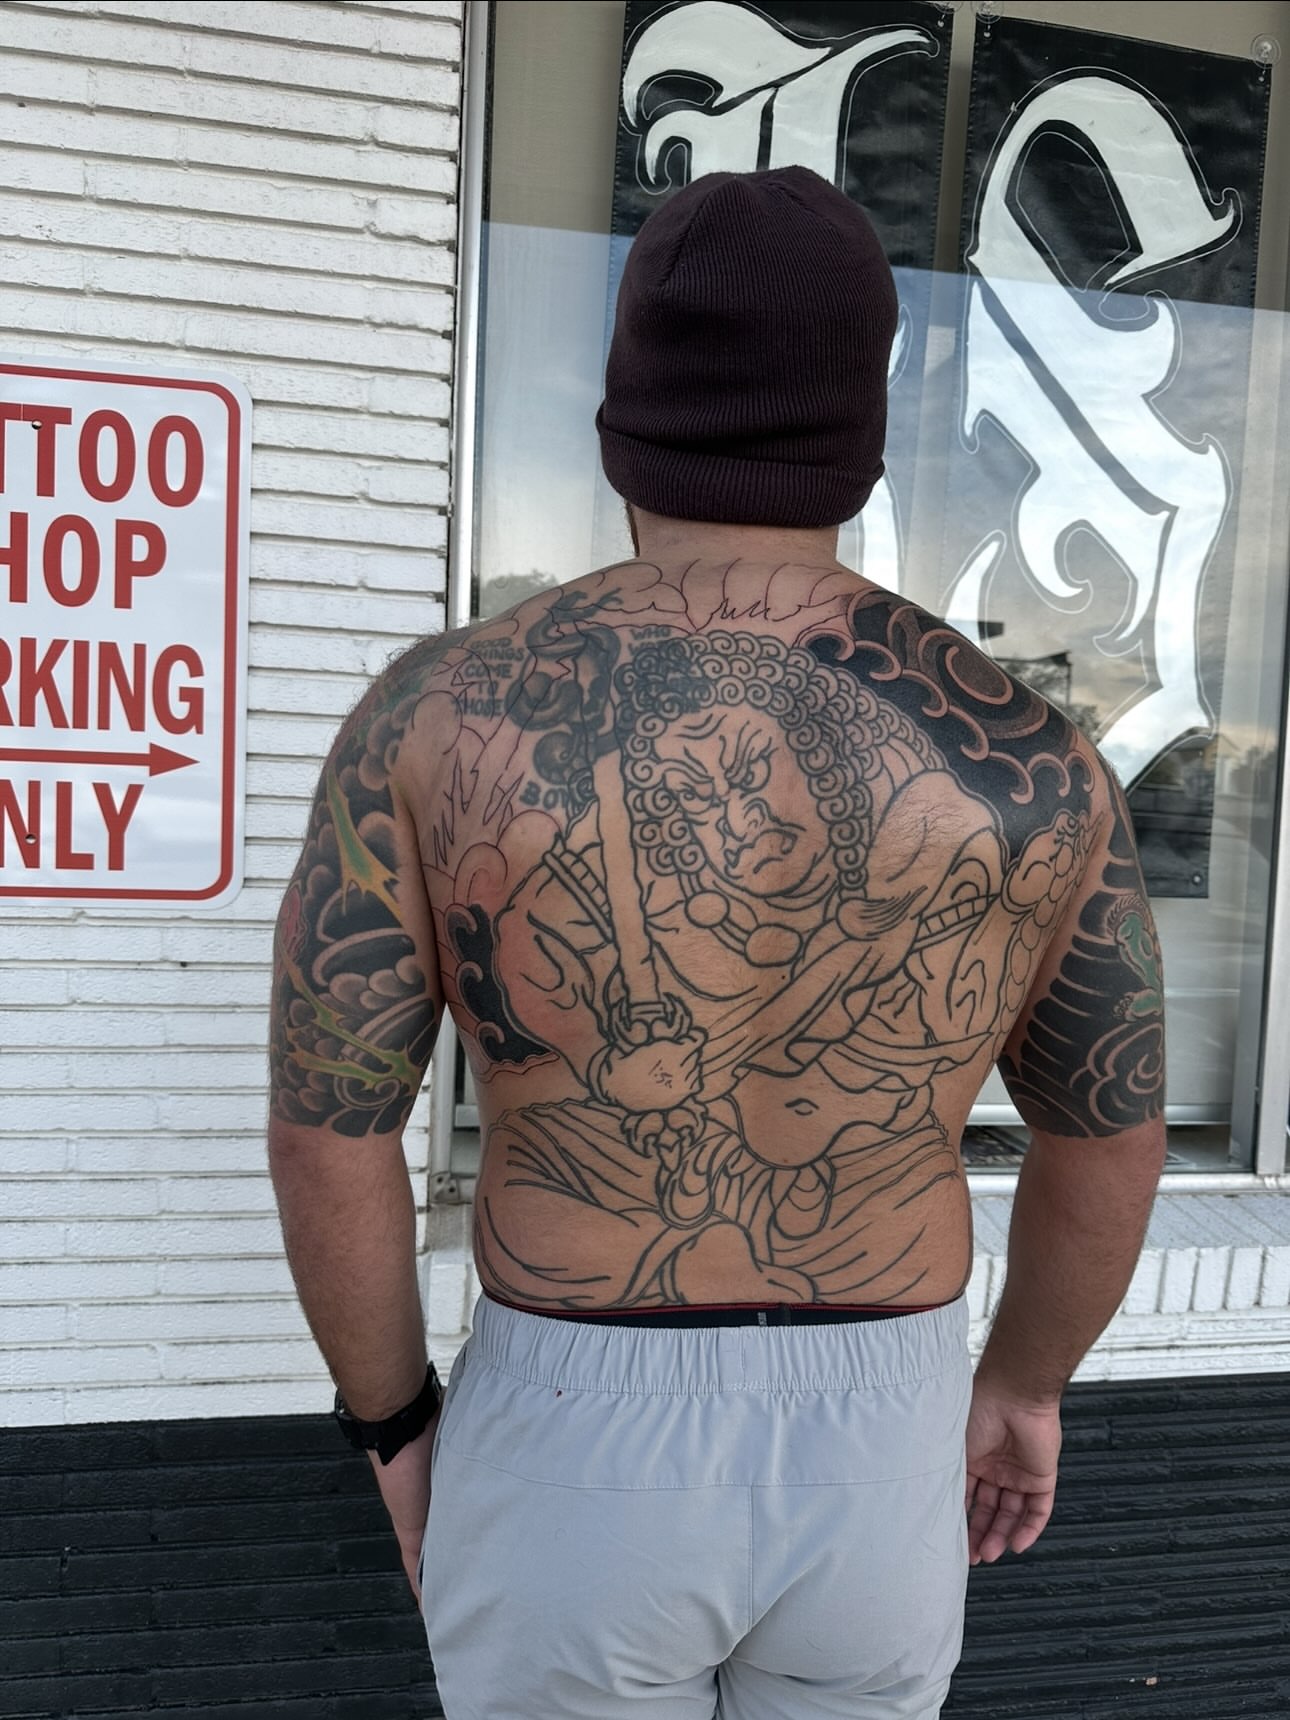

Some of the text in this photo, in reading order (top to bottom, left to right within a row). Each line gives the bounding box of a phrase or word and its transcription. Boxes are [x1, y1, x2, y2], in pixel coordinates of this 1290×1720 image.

[630, 627, 671, 640] WHO
[463, 663, 512, 679] COME
[0, 637, 204, 735] KING
